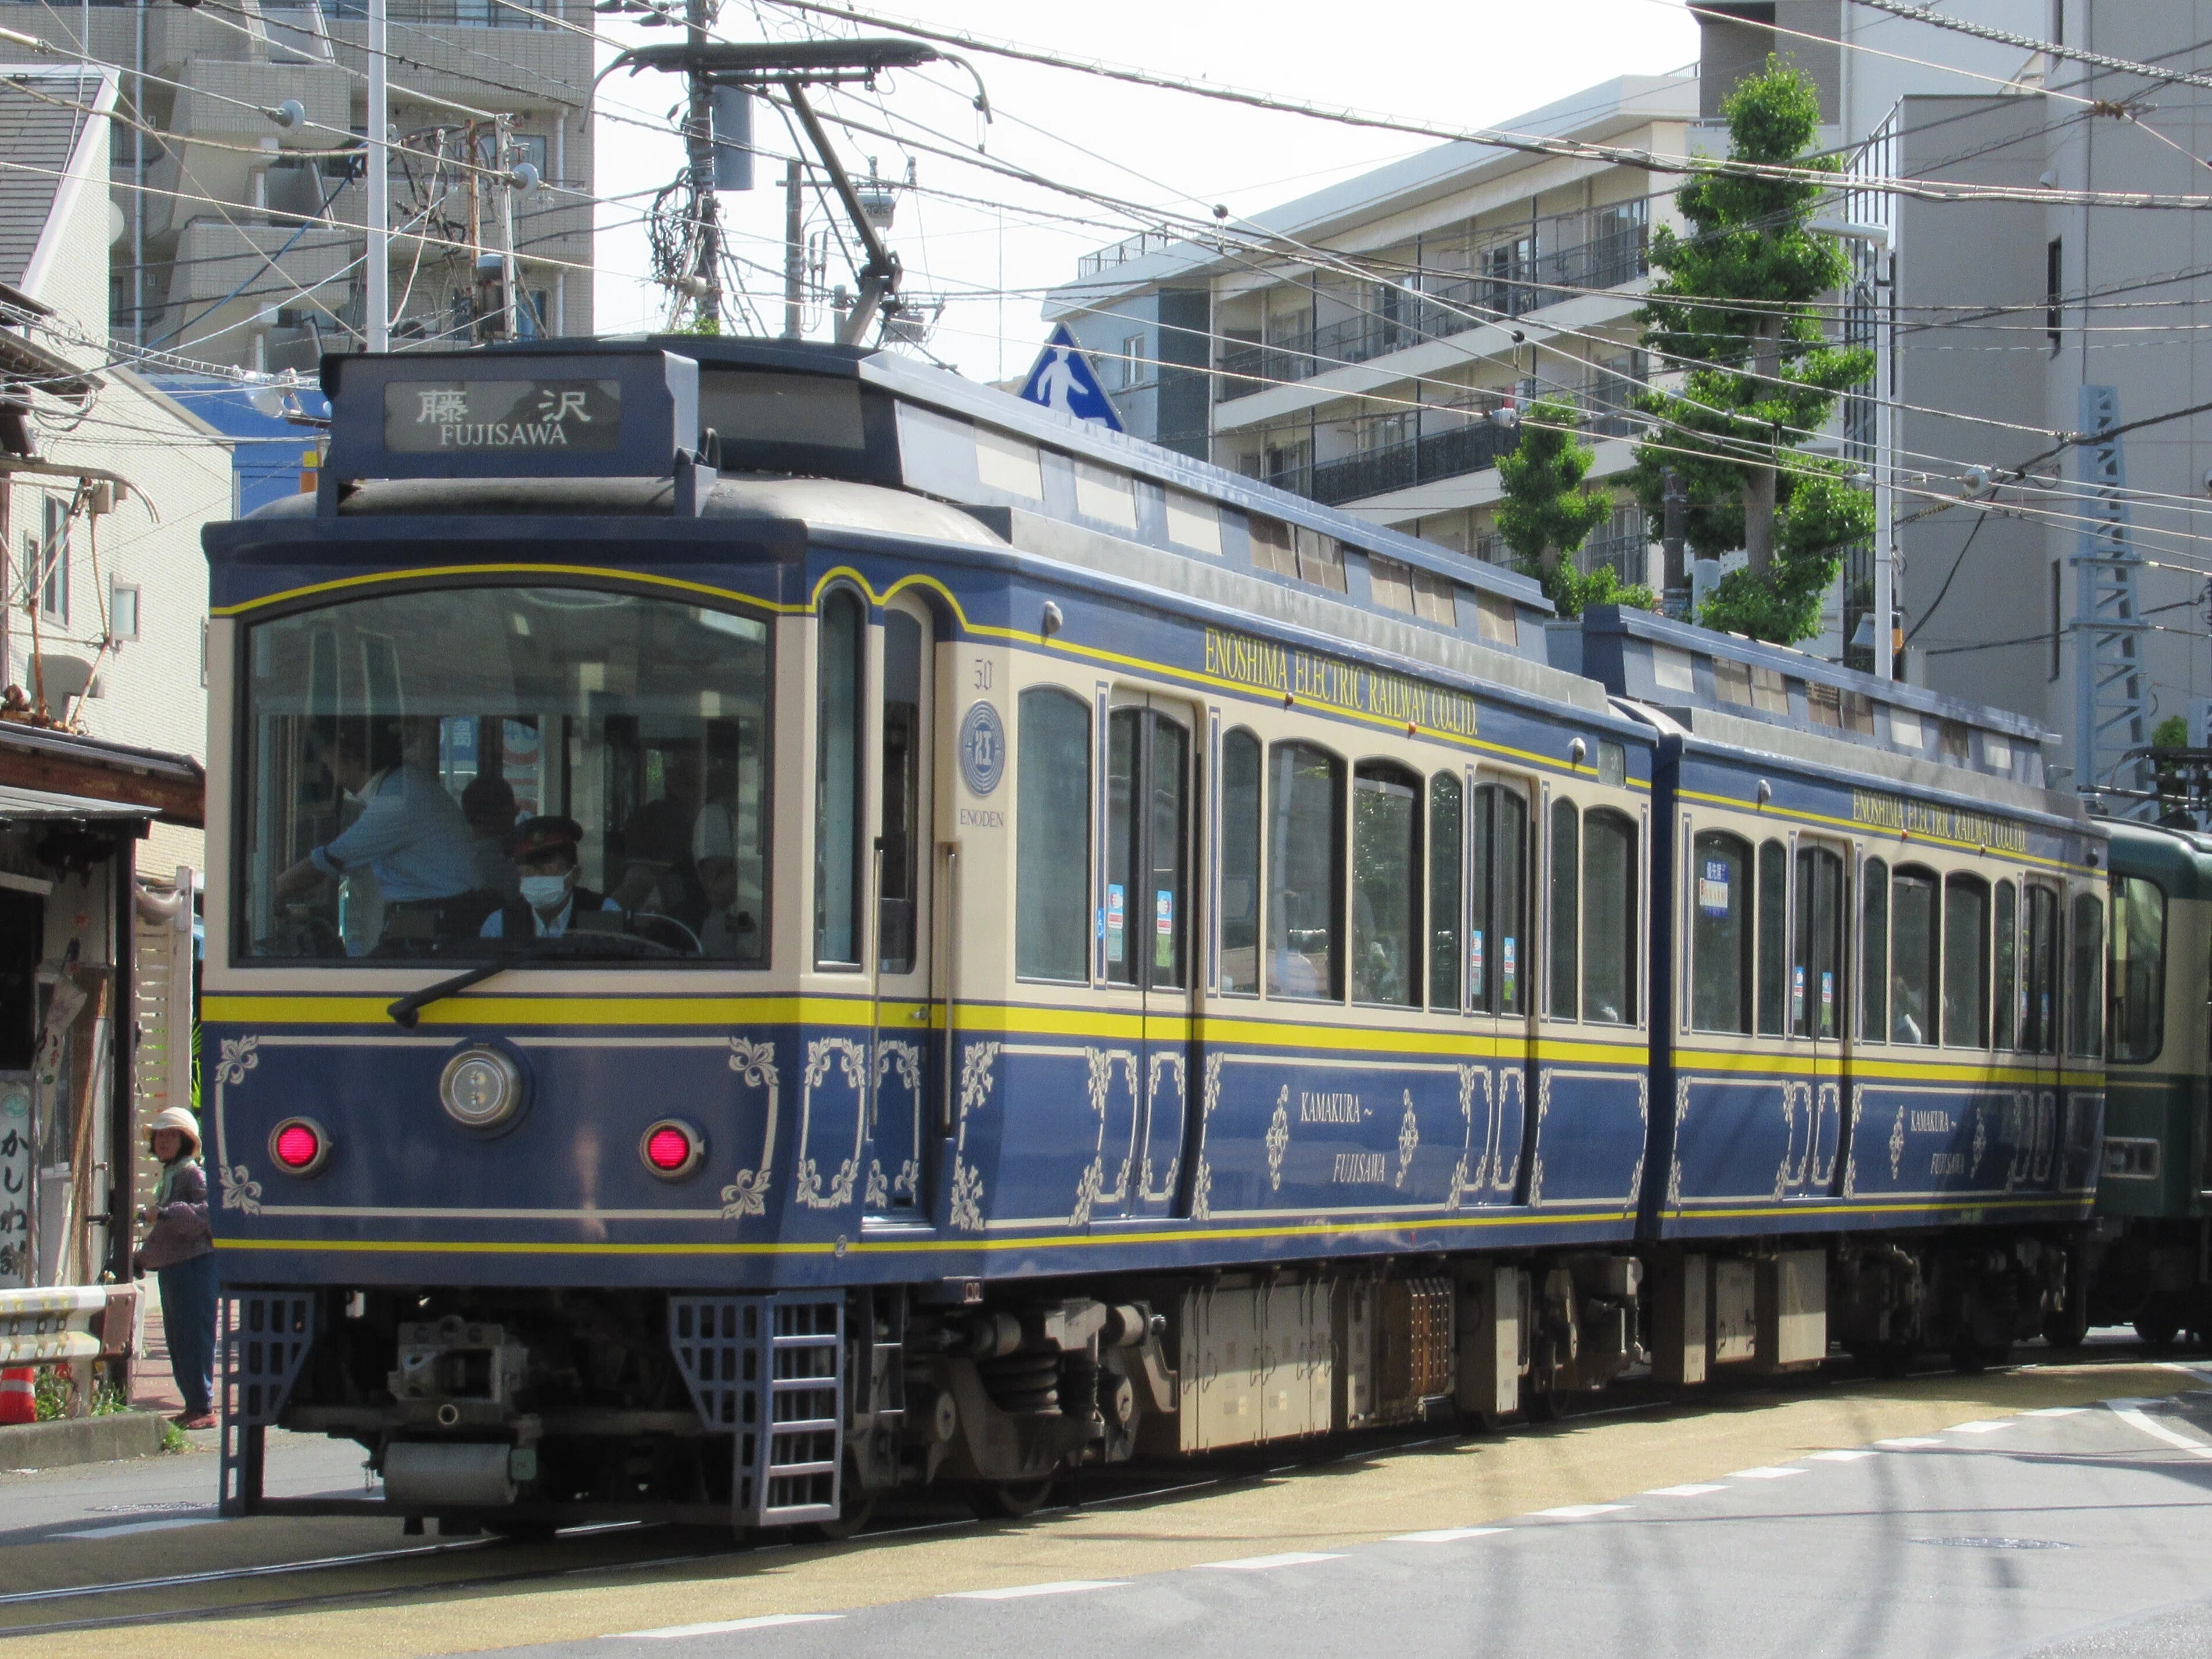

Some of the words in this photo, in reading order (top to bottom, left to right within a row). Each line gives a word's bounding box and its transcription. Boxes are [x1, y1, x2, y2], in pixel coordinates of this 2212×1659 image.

[416, 390, 591, 423] 藤沢
[440, 423, 568, 446] FUJISAWA
[974, 658, 993, 690] 50
[1205, 627, 1288, 690] ENOSHIMA
[1295, 651, 1363, 709] ELECTRIC
[1369, 670, 1428, 724] RAILWAY
[960, 809, 1004, 827] ENODEN
[1853, 788, 1904, 828] ENOSHIMA
[1908, 799, 1950, 838] ELECTRIC
[1955, 810, 1992, 845] RAILWAY
[1301, 1092, 1360, 1123] KAMAKURA
[1911, 1110, 1949, 1132] KAMAKURA
[1333, 1154, 1385, 1183] FUJISAWA
